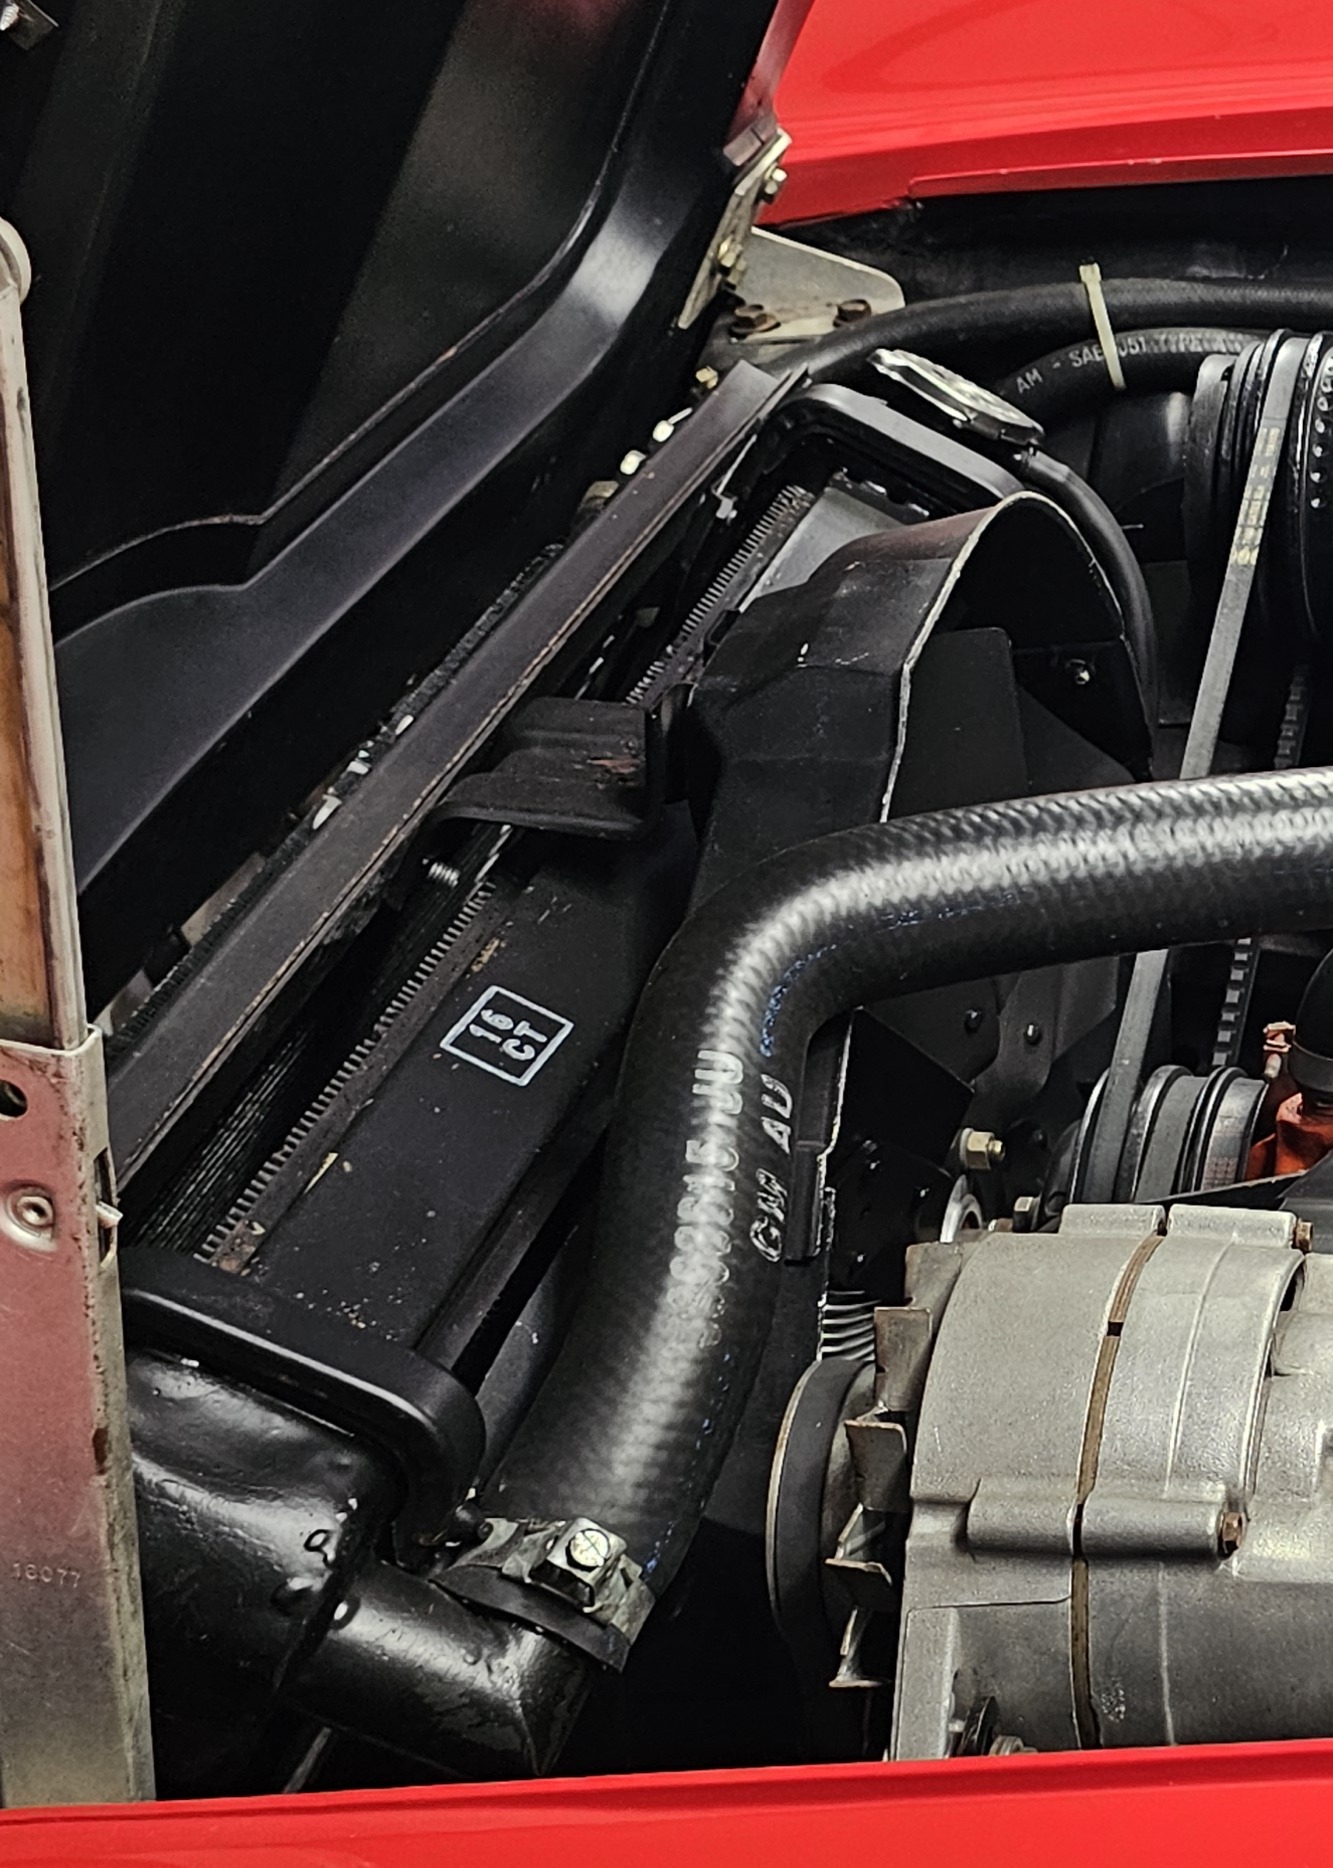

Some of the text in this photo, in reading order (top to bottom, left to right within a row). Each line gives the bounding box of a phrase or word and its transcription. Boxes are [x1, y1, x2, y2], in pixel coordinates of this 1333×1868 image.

[1016, 368, 1043, 394] AM
[1068, 344, 1104, 367] SAE
[469, 1009, 514, 1044] 16
[502, 1020, 547, 1060] CT
[749, 1167, 789, 1262] GM
